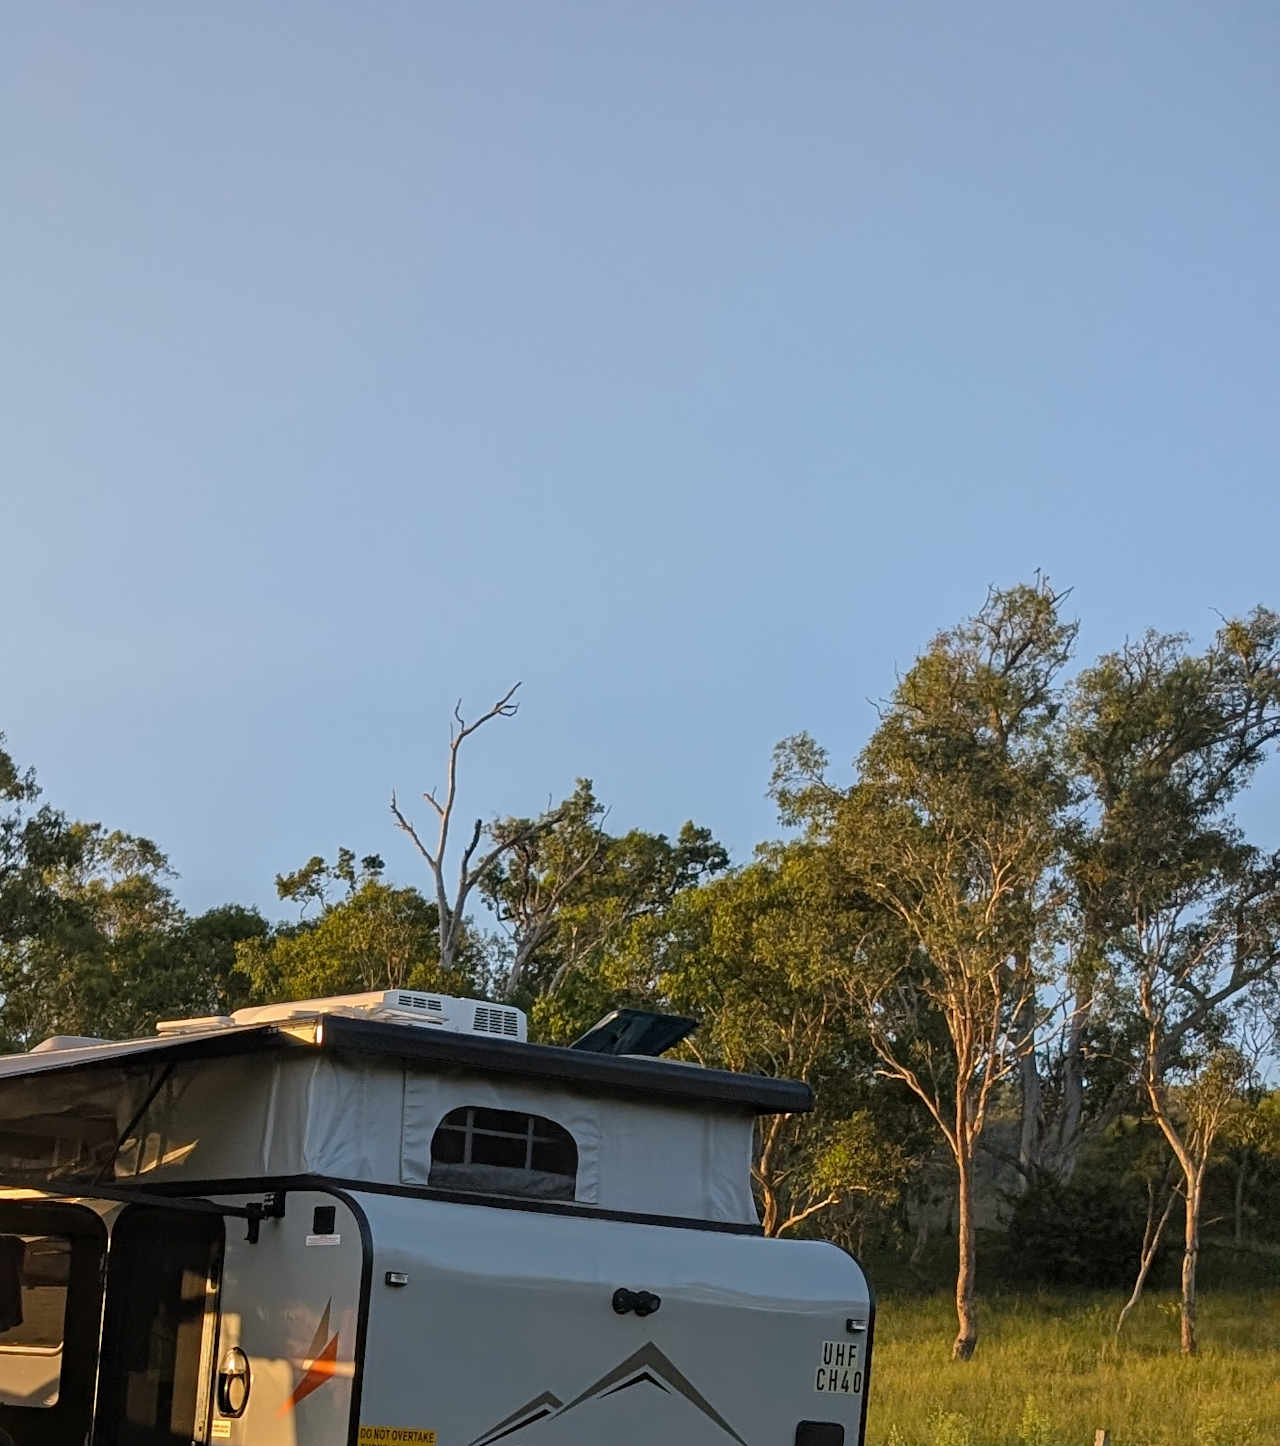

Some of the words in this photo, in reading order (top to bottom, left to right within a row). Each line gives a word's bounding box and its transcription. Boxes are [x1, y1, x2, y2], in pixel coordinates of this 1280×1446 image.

[823, 1342, 857, 1367] UHF
[816, 1368, 862, 1393] CH40
[360, 1428, 372, 1439] DO
[374, 1428, 391, 1441] NOT
[391, 1430, 435, 1443] OVERTAKE
